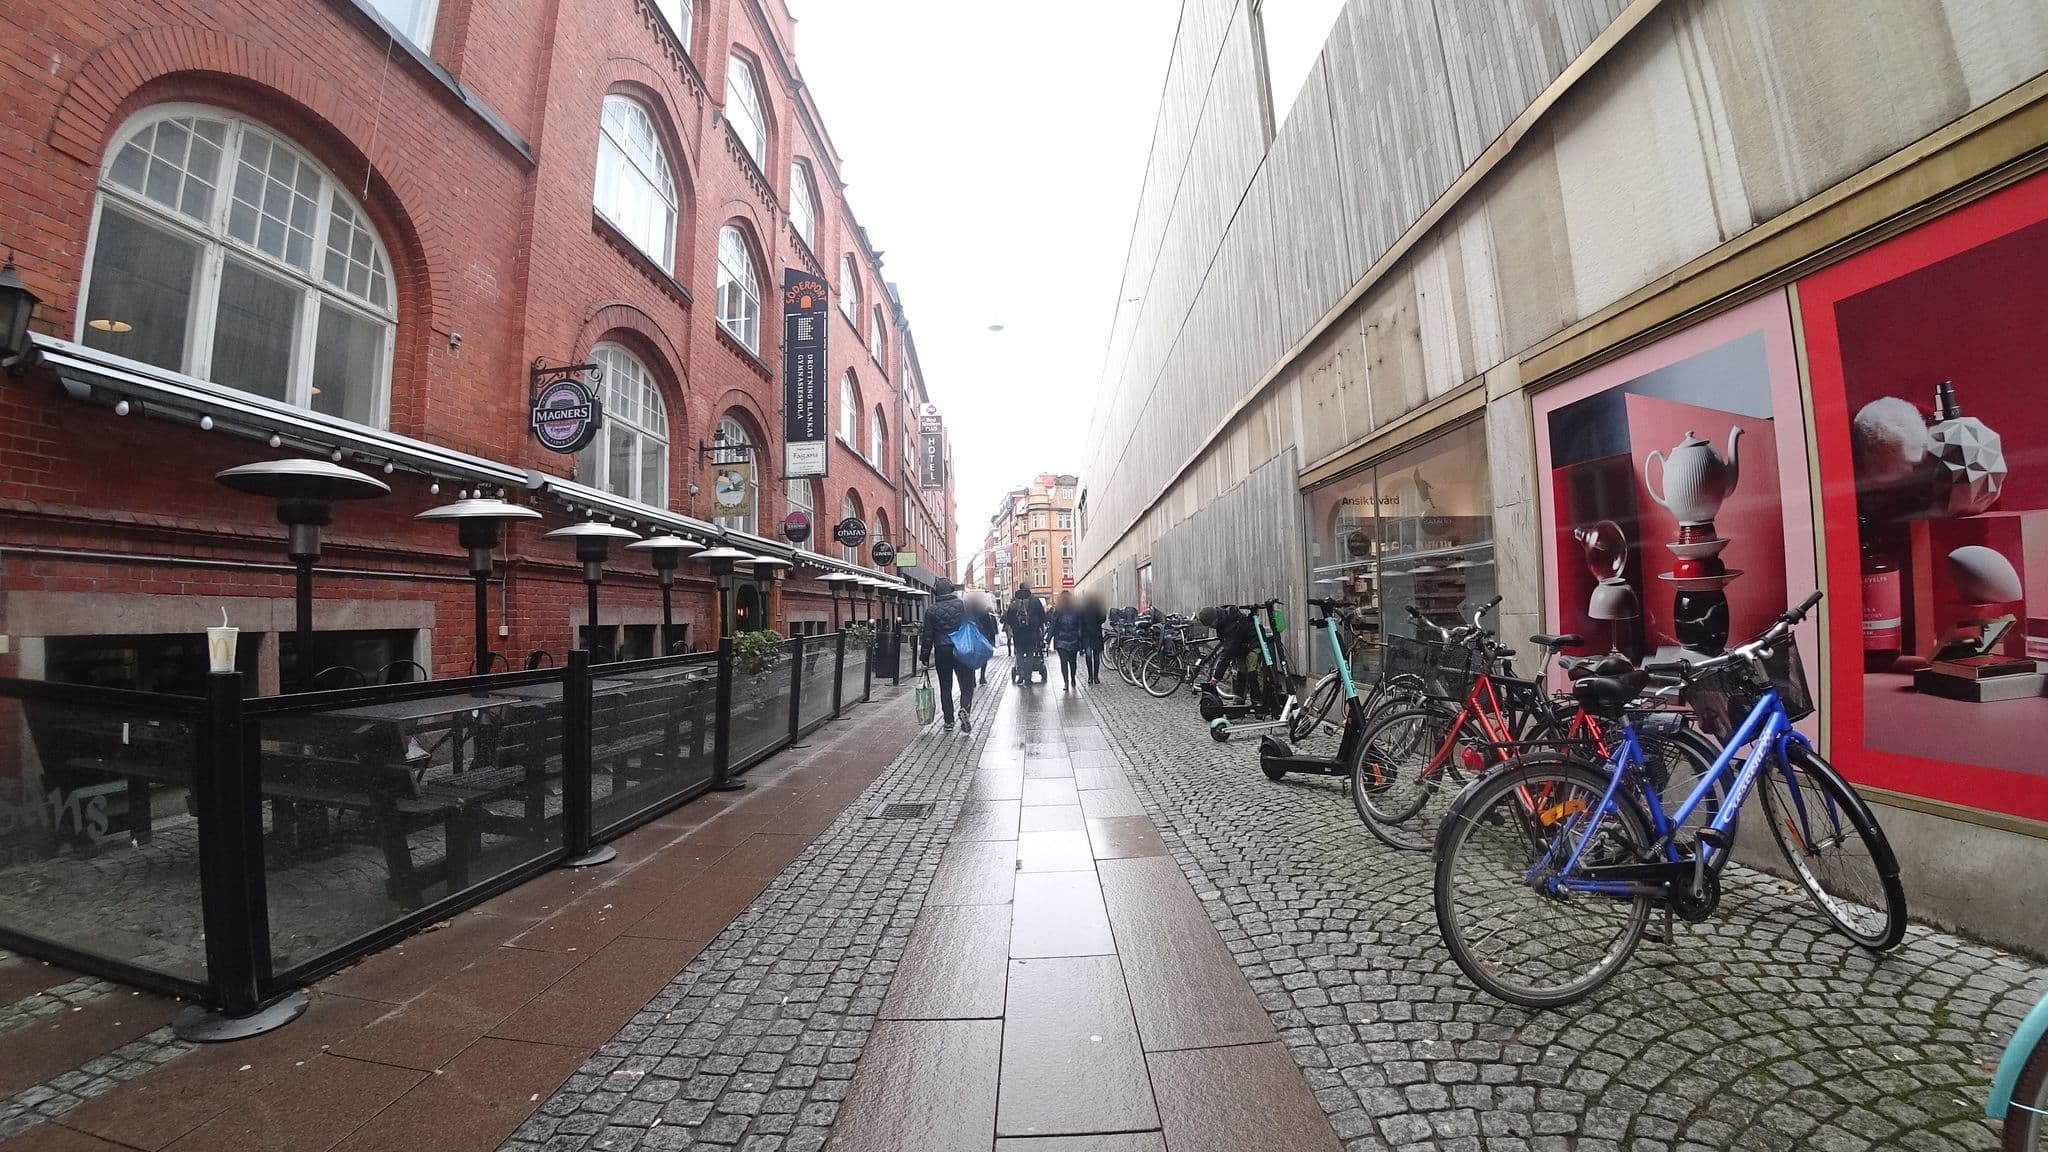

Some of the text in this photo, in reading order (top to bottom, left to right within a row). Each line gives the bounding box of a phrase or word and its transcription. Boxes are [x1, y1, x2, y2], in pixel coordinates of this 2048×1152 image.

[537, 407, 588, 421] MAGNERS
[928, 437, 936, 480] HOTEL
[1342, 496, 1400, 505] Ansiktvård
